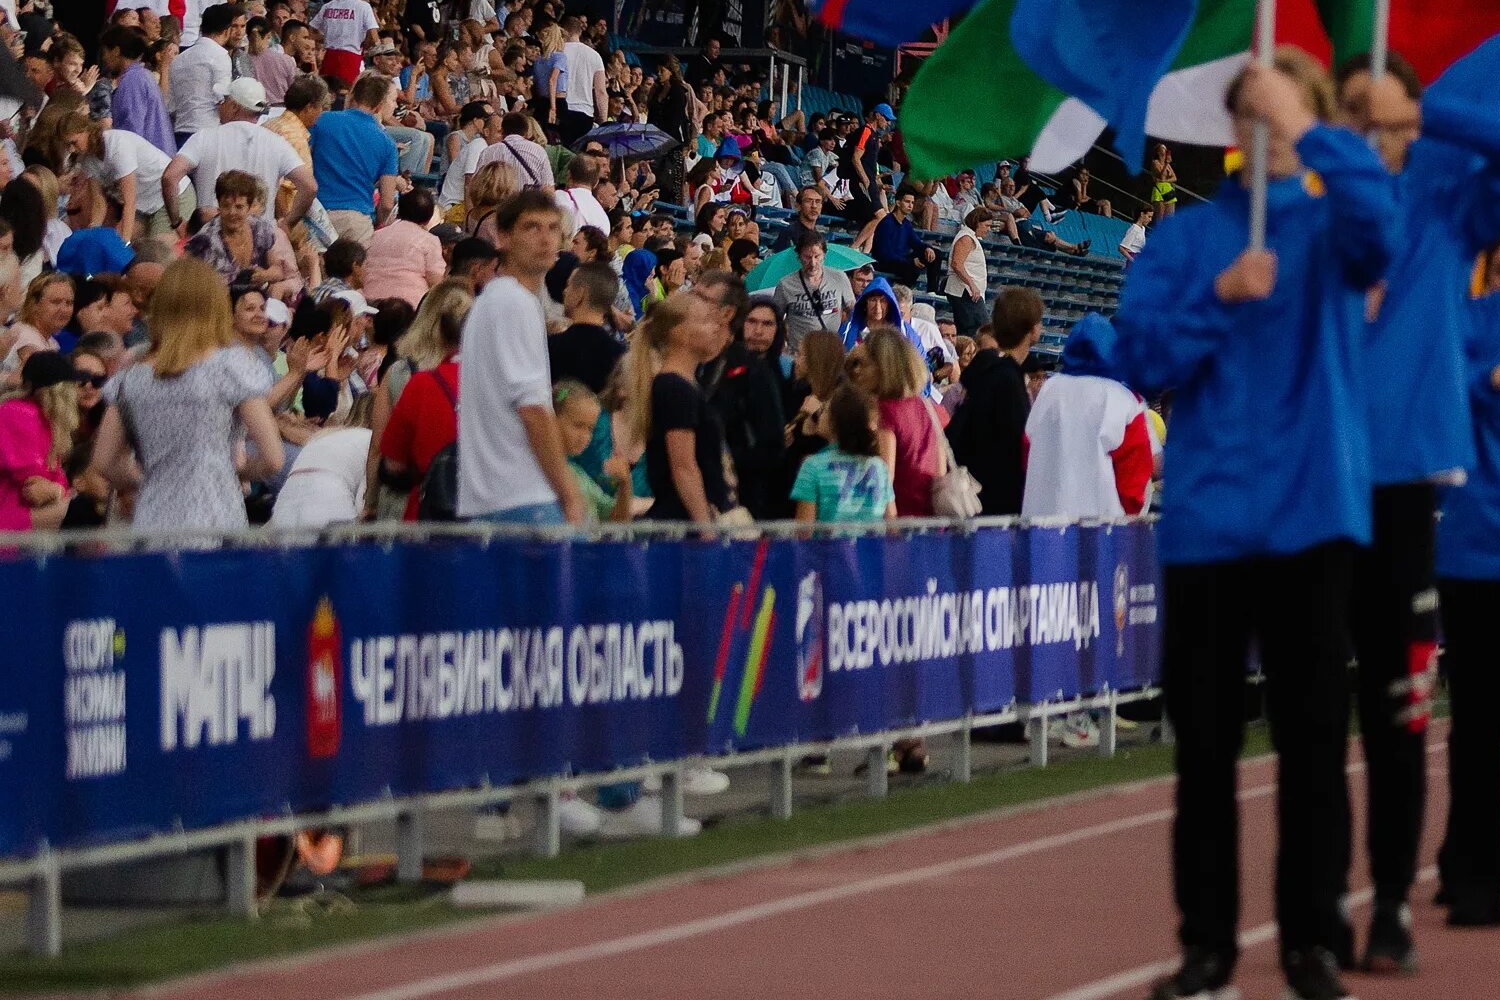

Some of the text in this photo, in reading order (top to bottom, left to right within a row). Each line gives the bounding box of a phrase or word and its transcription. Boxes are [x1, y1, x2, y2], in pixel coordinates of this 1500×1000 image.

[351, 619, 684, 725] ЧЕЛЯБИНСКАЯ ОБЛАСТЬ
[829, 577, 1099, 670] ВСЕРОССИЙСКАЯ СПАРТАКИАДА
